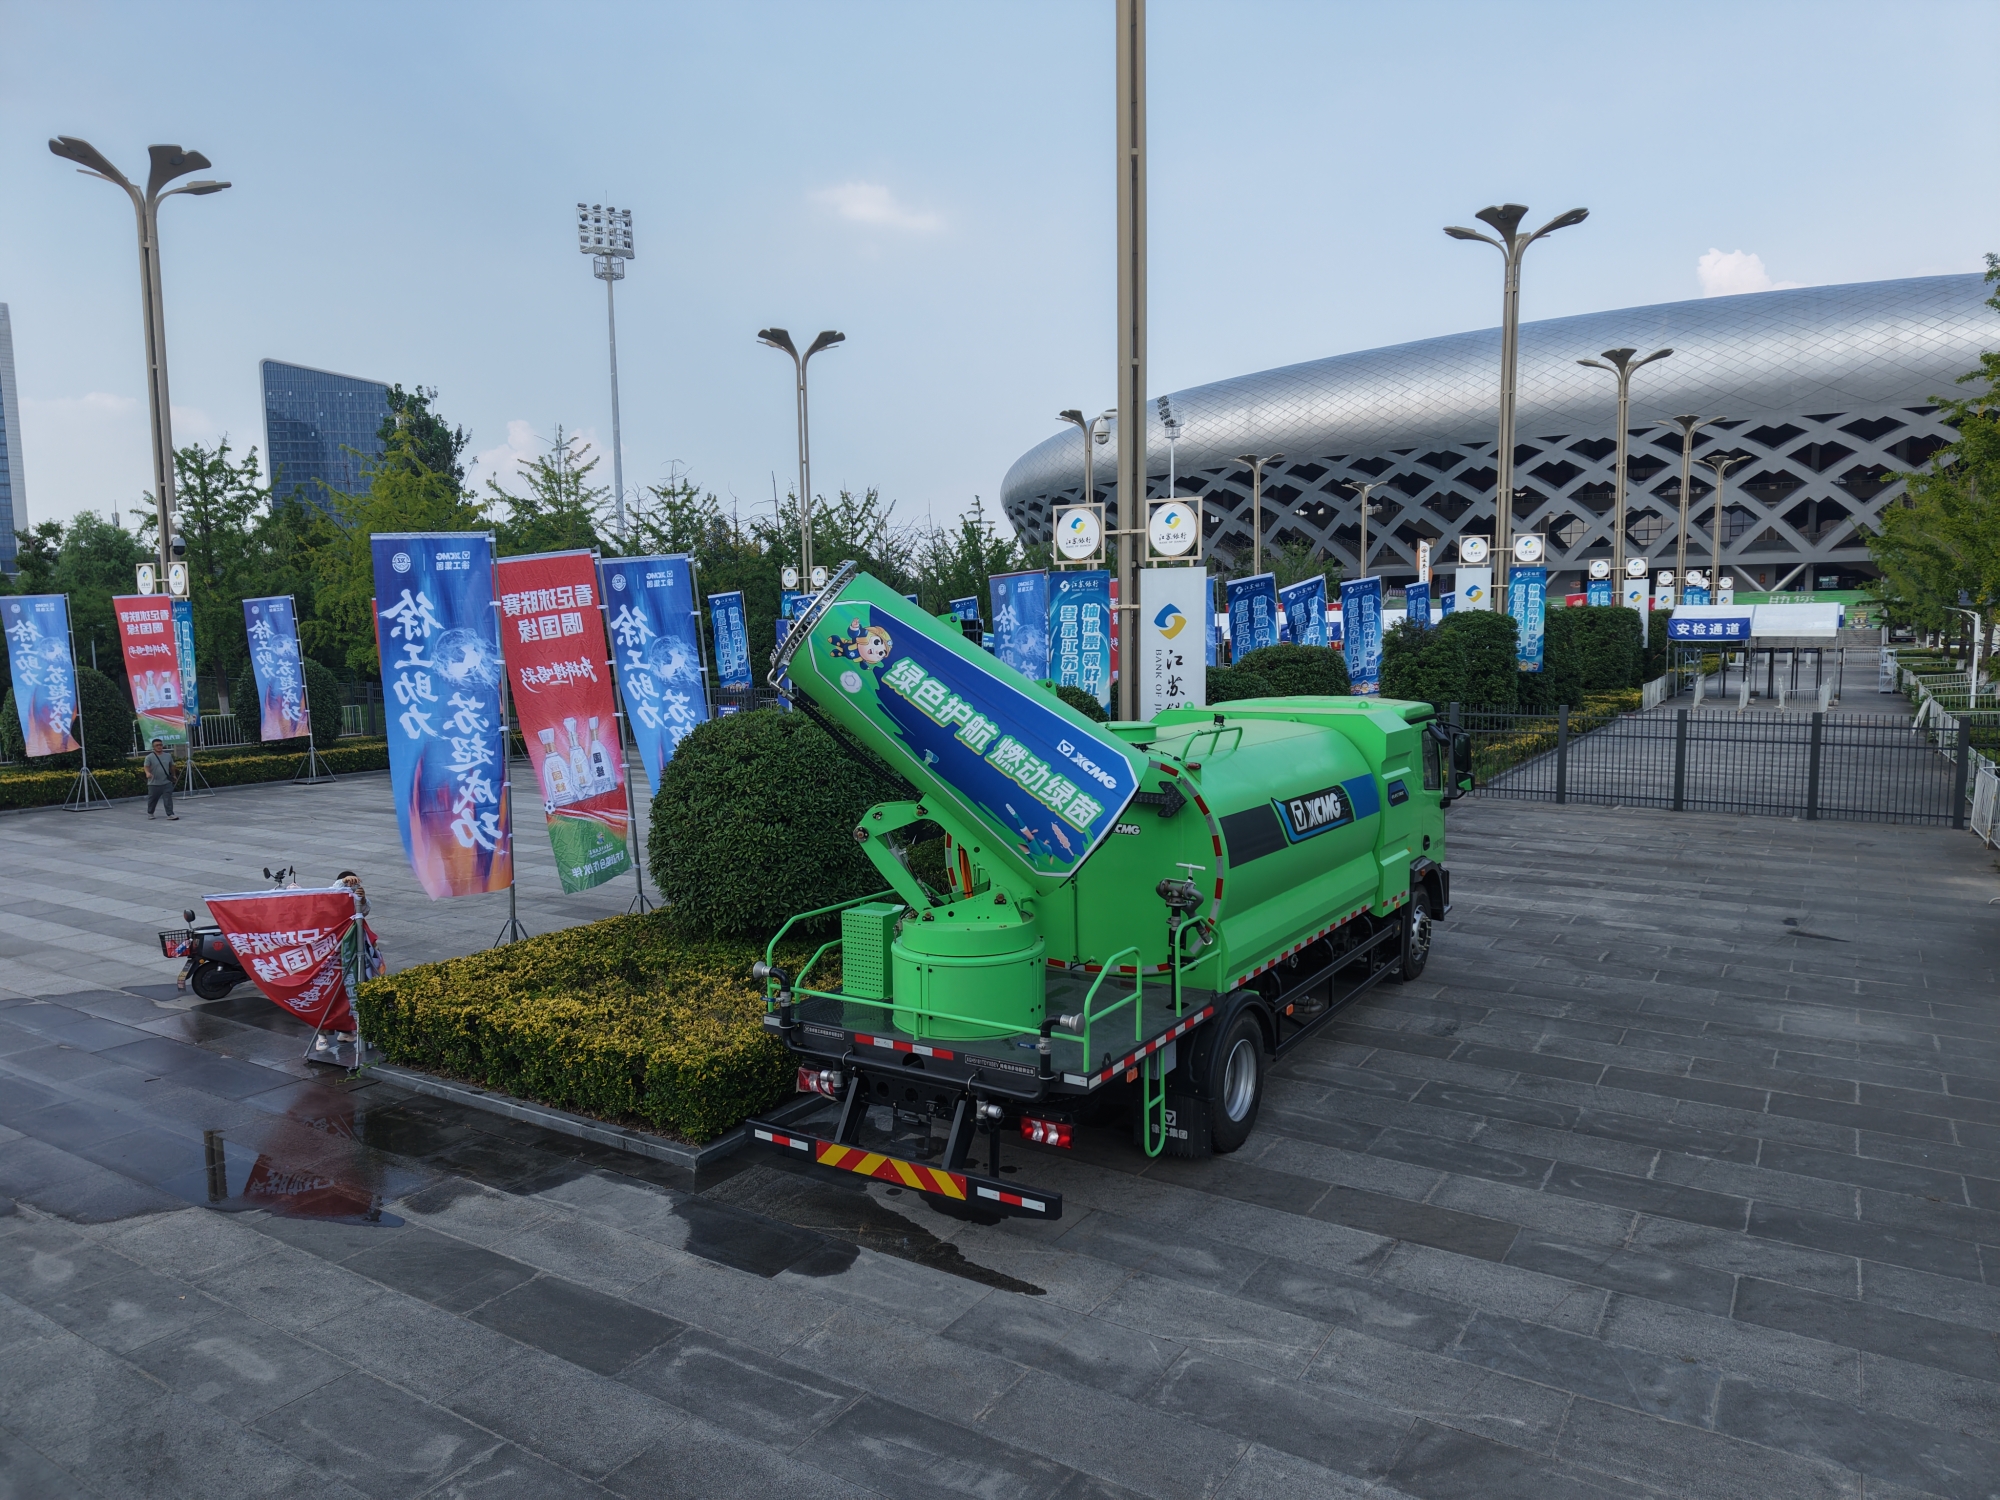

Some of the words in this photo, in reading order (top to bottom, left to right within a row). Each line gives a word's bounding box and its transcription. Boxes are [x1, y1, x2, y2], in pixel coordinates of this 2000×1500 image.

[1066, 537, 1091, 545] 江苏银行
[1159, 533, 1187, 541] 江苏银行
[1082, 603, 1101, 650] 抽球票
[1676, 622, 1741, 636] 安检通道
[1060, 605, 1079, 686] 登录江苏银
[1082, 651, 1101, 697] 领好礼
[1155, 684, 1162, 698] OF
[885, 659, 998, 751] 绿色护航
[989, 737, 1102, 829] 燃动绿茵
[1070, 751, 1118, 790] XCMG
[1304, 792, 1341, 828] XCMG
[1113, 824, 1141, 835] CMG
